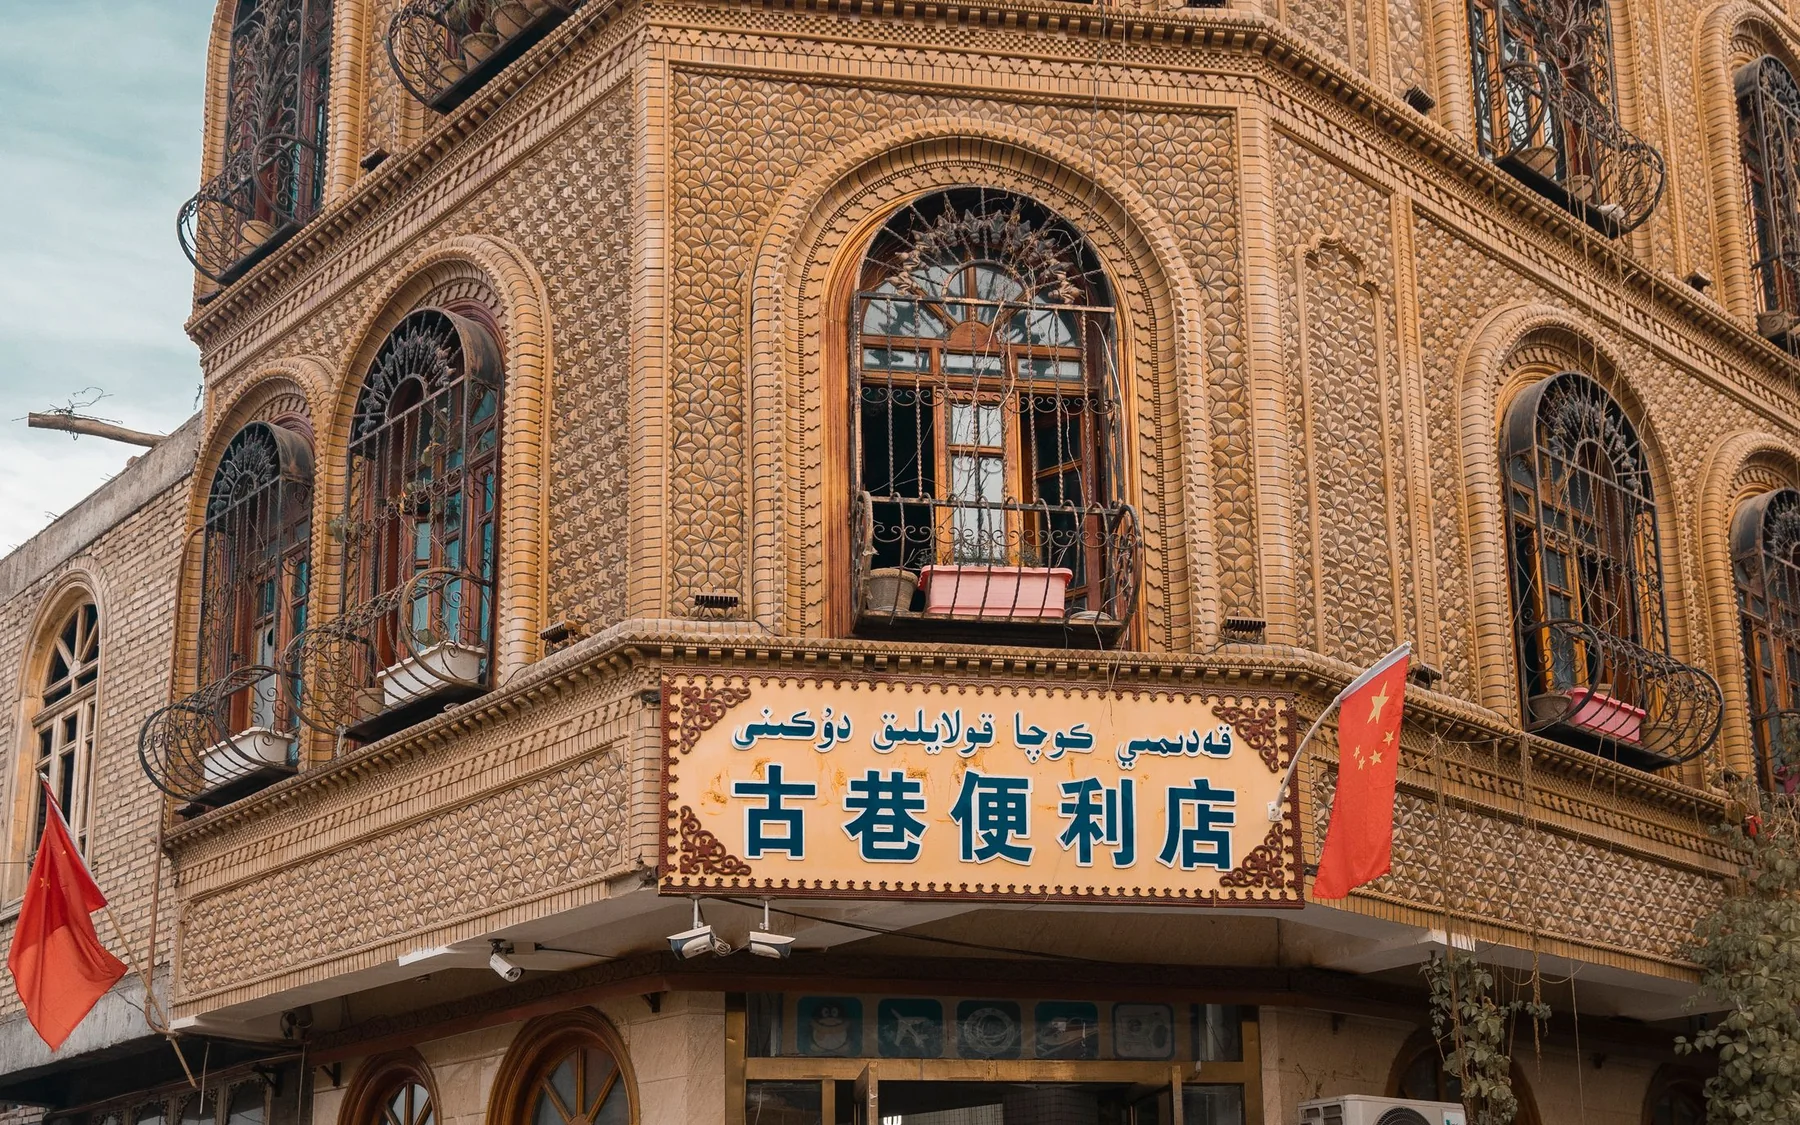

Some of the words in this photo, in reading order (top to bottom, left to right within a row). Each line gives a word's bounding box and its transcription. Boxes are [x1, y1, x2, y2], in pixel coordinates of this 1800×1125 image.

[733, 707, 853, 751] دۇكىنى
[872, 708, 995, 754] قولايلىق
[1014, 712, 1095, 761] كوچا
[732, 762, 1237, 870] 古巷便利店
